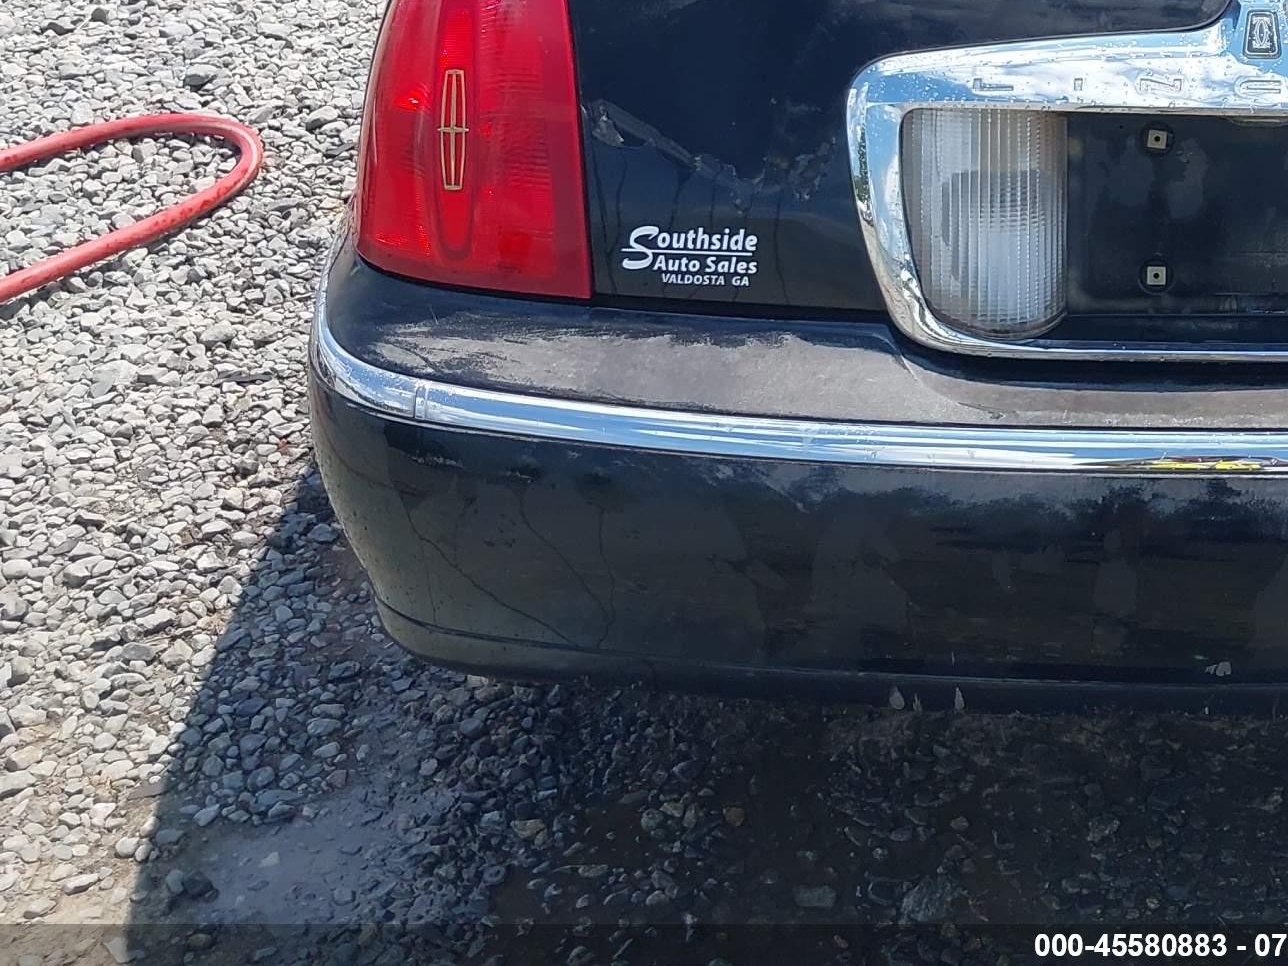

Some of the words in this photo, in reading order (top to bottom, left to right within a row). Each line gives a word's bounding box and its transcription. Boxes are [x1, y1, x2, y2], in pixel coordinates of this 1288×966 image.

[621, 225, 758, 270] Southside
[653, 255, 700, 271] Auto
[705, 256, 758, 274] Sales
[662, 273, 725, 286] VALDOSTA
[731, 275, 750, 287] GA
